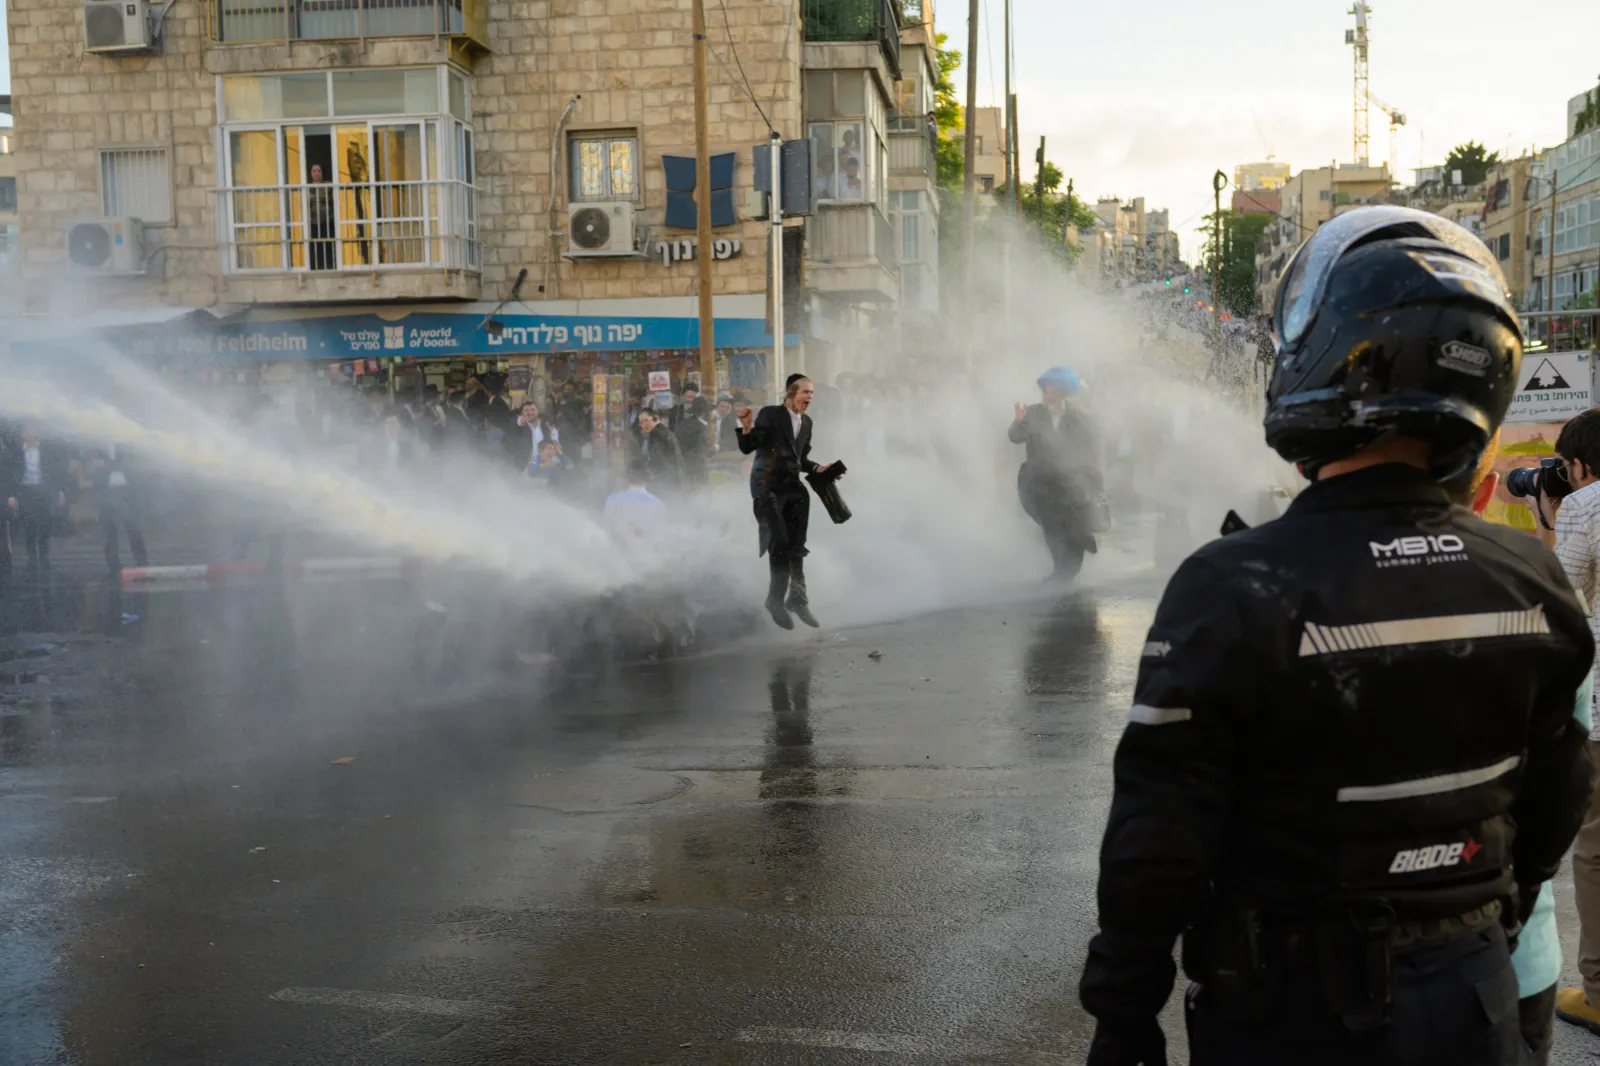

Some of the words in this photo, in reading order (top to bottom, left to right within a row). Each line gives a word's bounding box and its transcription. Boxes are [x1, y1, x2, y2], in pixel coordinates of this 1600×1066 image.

[655, 240, 693, 268] נוף
[711, 238, 740, 260] יפ
[217, 332, 307, 352] Feldheim
[409, 338, 422, 348] of
[423, 336, 457, 348] books
[410, 328, 418, 338] A
[420, 327, 452, 338] world
[573, 325, 603, 346] נוף
[607, 323, 643, 342] יפה
[1534, 393, 1550, 402] בור
[1552, 390, 1589, 401] זהירות!
[1368, 534, 1464, 558] MB10
